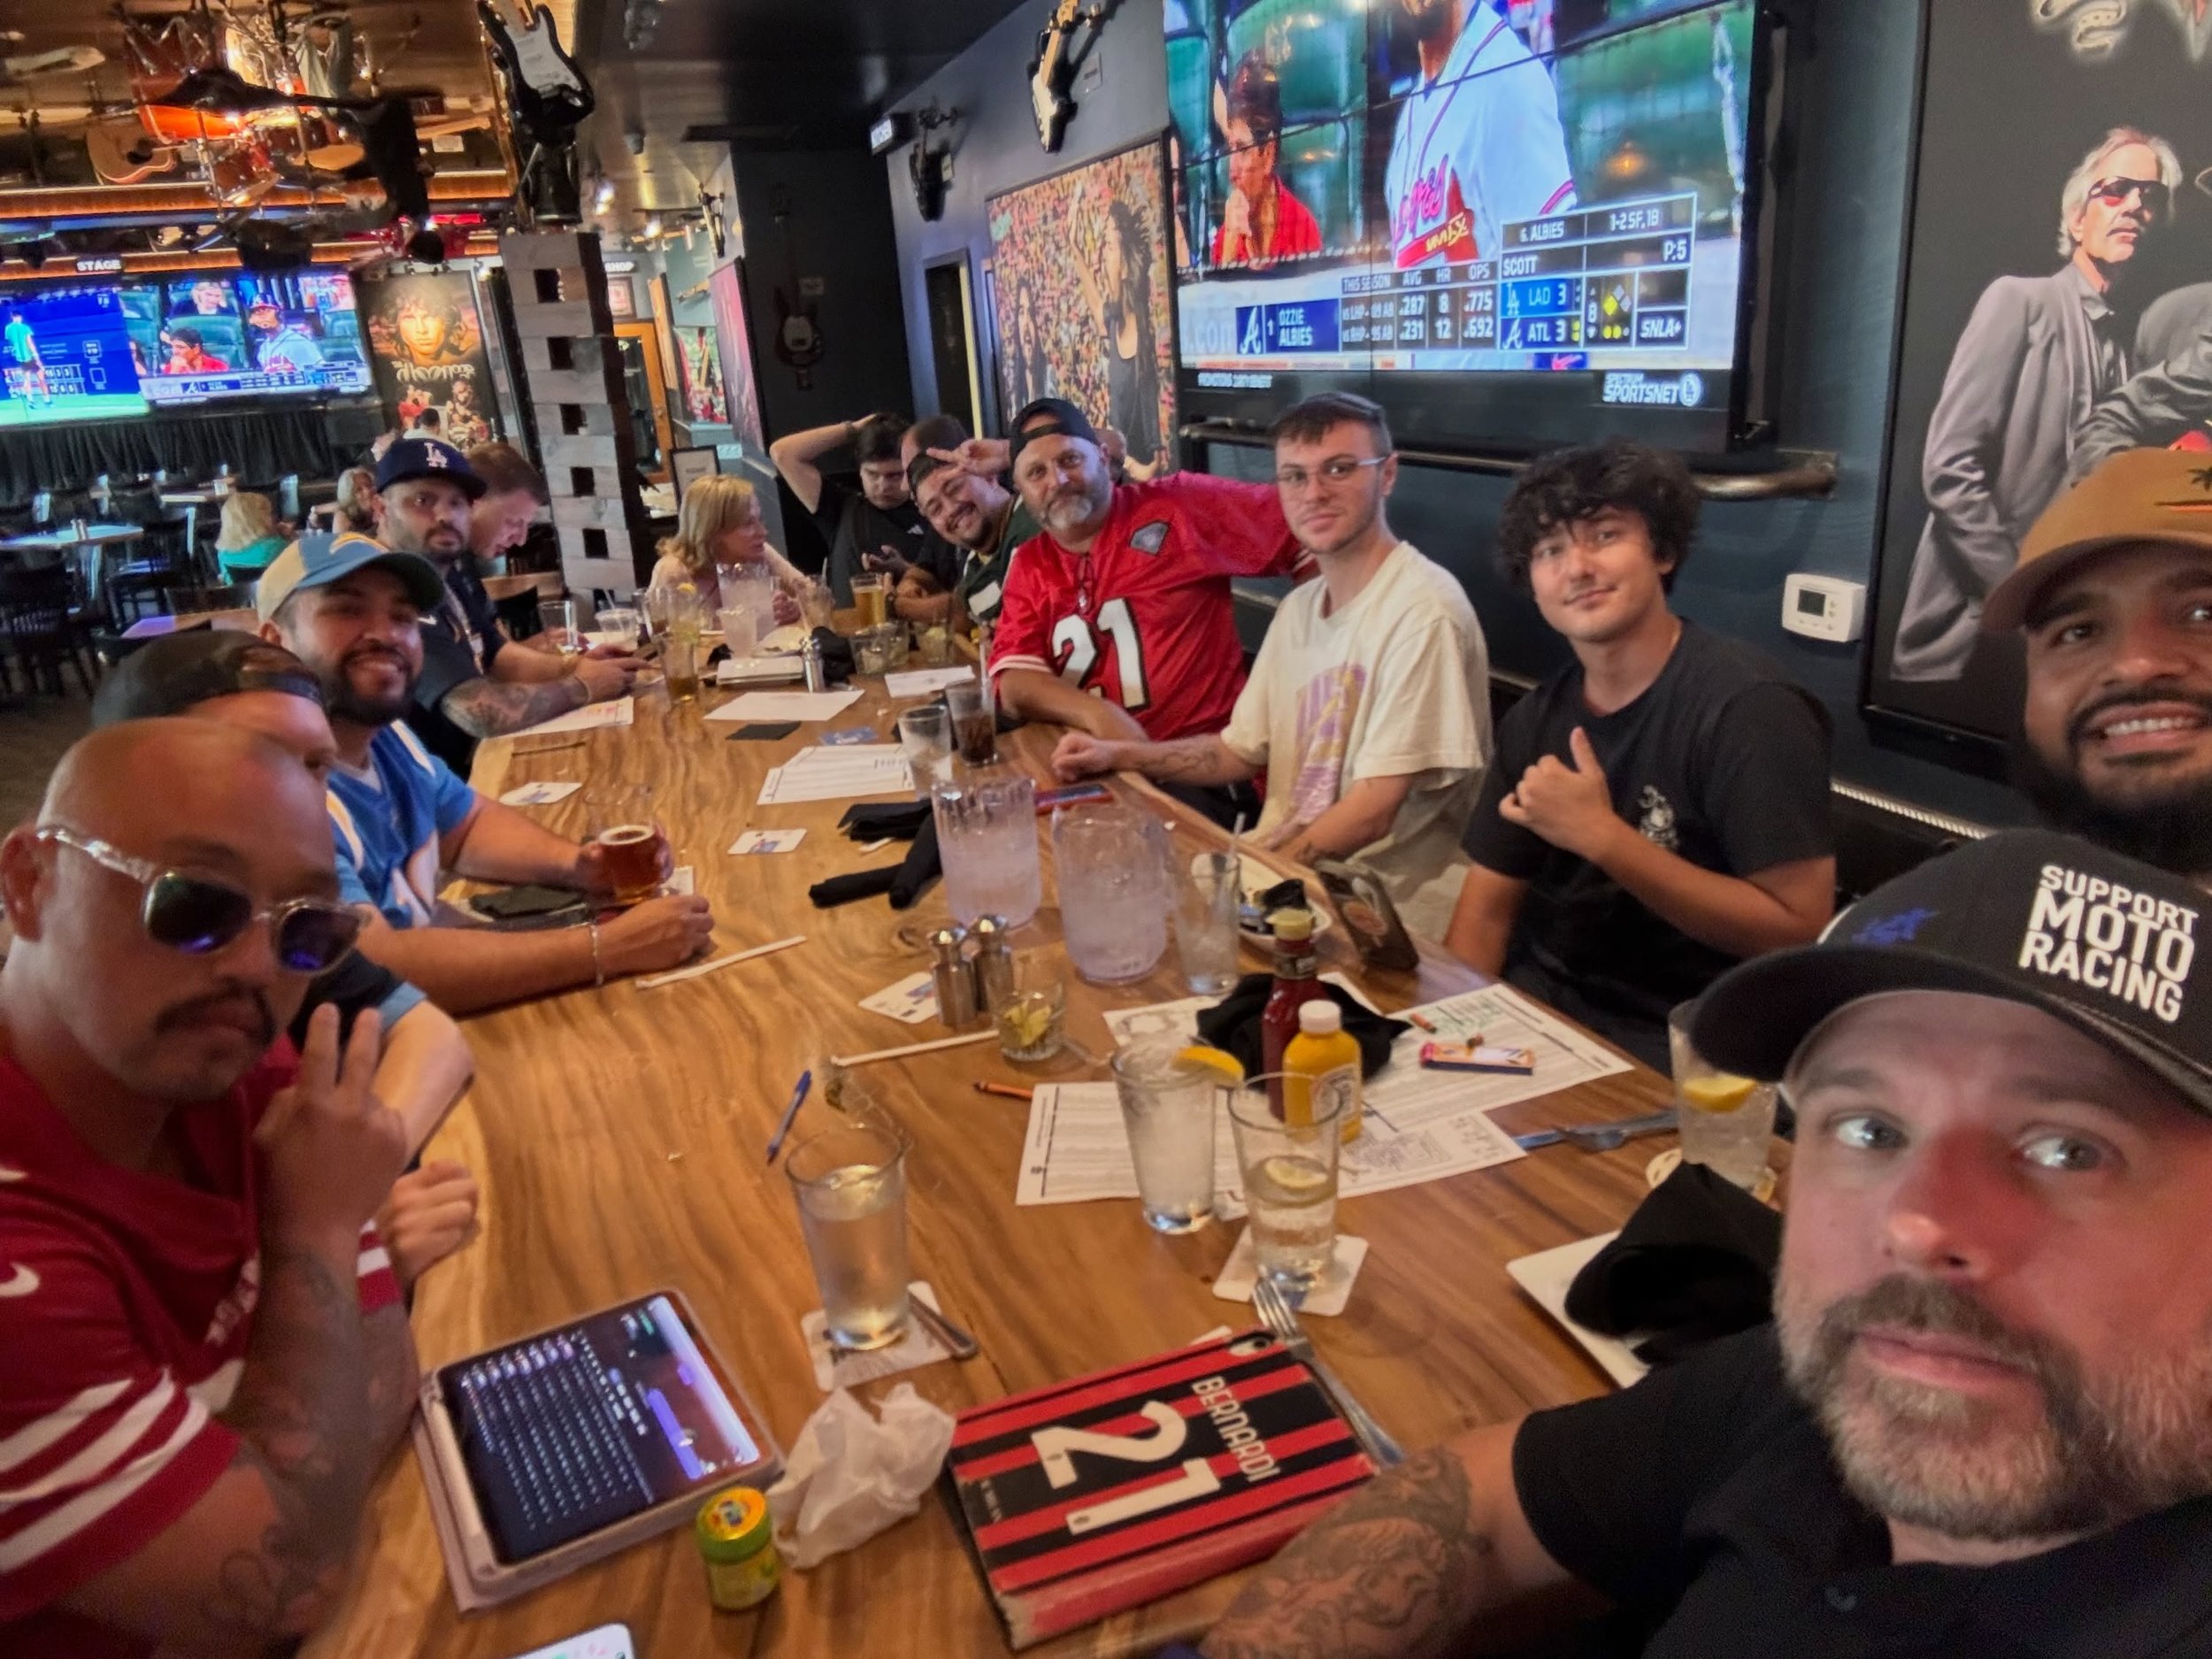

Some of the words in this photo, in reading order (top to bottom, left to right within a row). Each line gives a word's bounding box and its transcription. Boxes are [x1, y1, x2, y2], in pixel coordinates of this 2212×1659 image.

[1530, 221, 1564, 241] ALBIES
[76, 259, 122, 271] STAGE
[1436, 267, 1451, 283] HR
[1469, 264, 1490, 280] OPS
[1502, 255, 1539, 276] SCOTT
[1402, 270, 1422, 286] AVG
[1439, 292, 1449, 314] 8
[1463, 289, 1494, 312] .775
[1528, 287, 1551, 306] LAD
[1557, 283, 1567, 306] 3
[1279, 307, 1305, 326] OZZIE
[1463, 315, 1494, 338] .692
[1279, 326, 1312, 347] ALBIES
[1435, 317, 1452, 339] 12
[1527, 321, 1551, 342] ATL
[1555, 319, 1566, 342] 3
[1602, 383, 1679, 404] SPORTSNET
[424, 442, 448, 467] LA
[2039, 864, 2200, 935] SUPPORT
[2028, 889, 2196, 983] MOTO
[2018, 930, 2184, 1023] RACING
[1191, 1375, 1281, 1483] BERNARDI
[1032, 1400, 1222, 1536] 21
